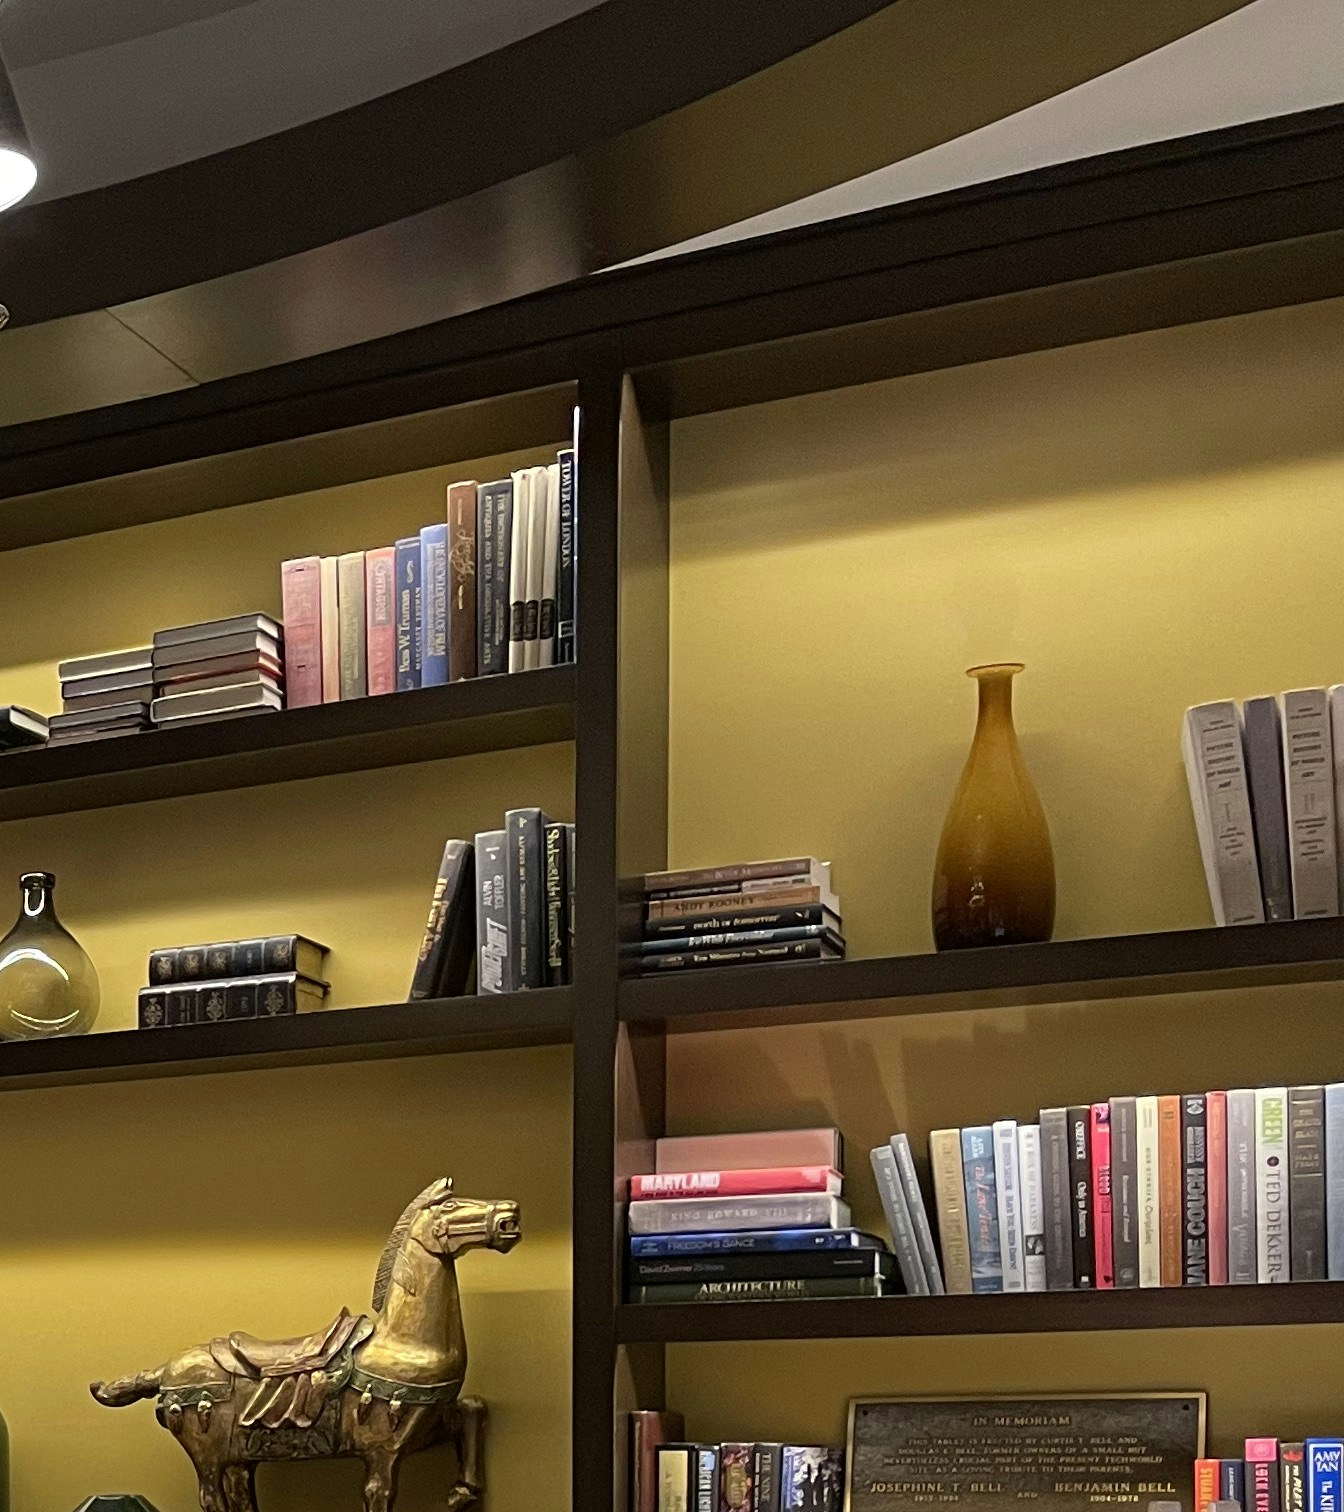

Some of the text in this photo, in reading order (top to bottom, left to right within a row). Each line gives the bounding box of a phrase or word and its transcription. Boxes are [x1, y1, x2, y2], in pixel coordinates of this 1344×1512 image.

[559, 462, 571, 568] TOWER OF LONDON
[398, 649, 410, 673] Bess
[482, 880, 493, 906] ALVIN
[493, 874, 505, 910] TOFFLER
[673, 898, 753, 911] ANDY ROONEY
[708, 946, 789, 961] Minutes Normal
[1261, 1096, 1284, 1143] GREEN
[640, 1171, 721, 1192] MARYLAND
[1187, 1167, 1206, 1235] COUCH
[706, 1208, 758, 1220] EDWARD
[1266, 1170, 1282, 1274] TED DEKKER
[667, 1238, 755, 1251] FREEDOM'S DANCE
[638, 1263, 692, 1274] David Zwirner
[1187, 1239, 1206, 1284] JANE
[697, 1280, 806, 1296] ARCHITECTURE
[972, 1416, 1072, 1426] IN MEMORIAM
[761, 1452, 772, 1474] THE
[1314, 1450, 1341, 1460] AMY
[1255, 1463, 1270, 1490] LOCK
[1315, 1460, 1340, 1473] TAN
[761, 1476, 772, 1502] NINE
[870, 1482, 1002, 1494] JOSEPHINE BELL
[1016, 1491, 1038, 1499] AND
[1054, 1481, 1176, 1493] BENJAMIN BELL
[1292, 1477, 1303, 1508] MEAT
